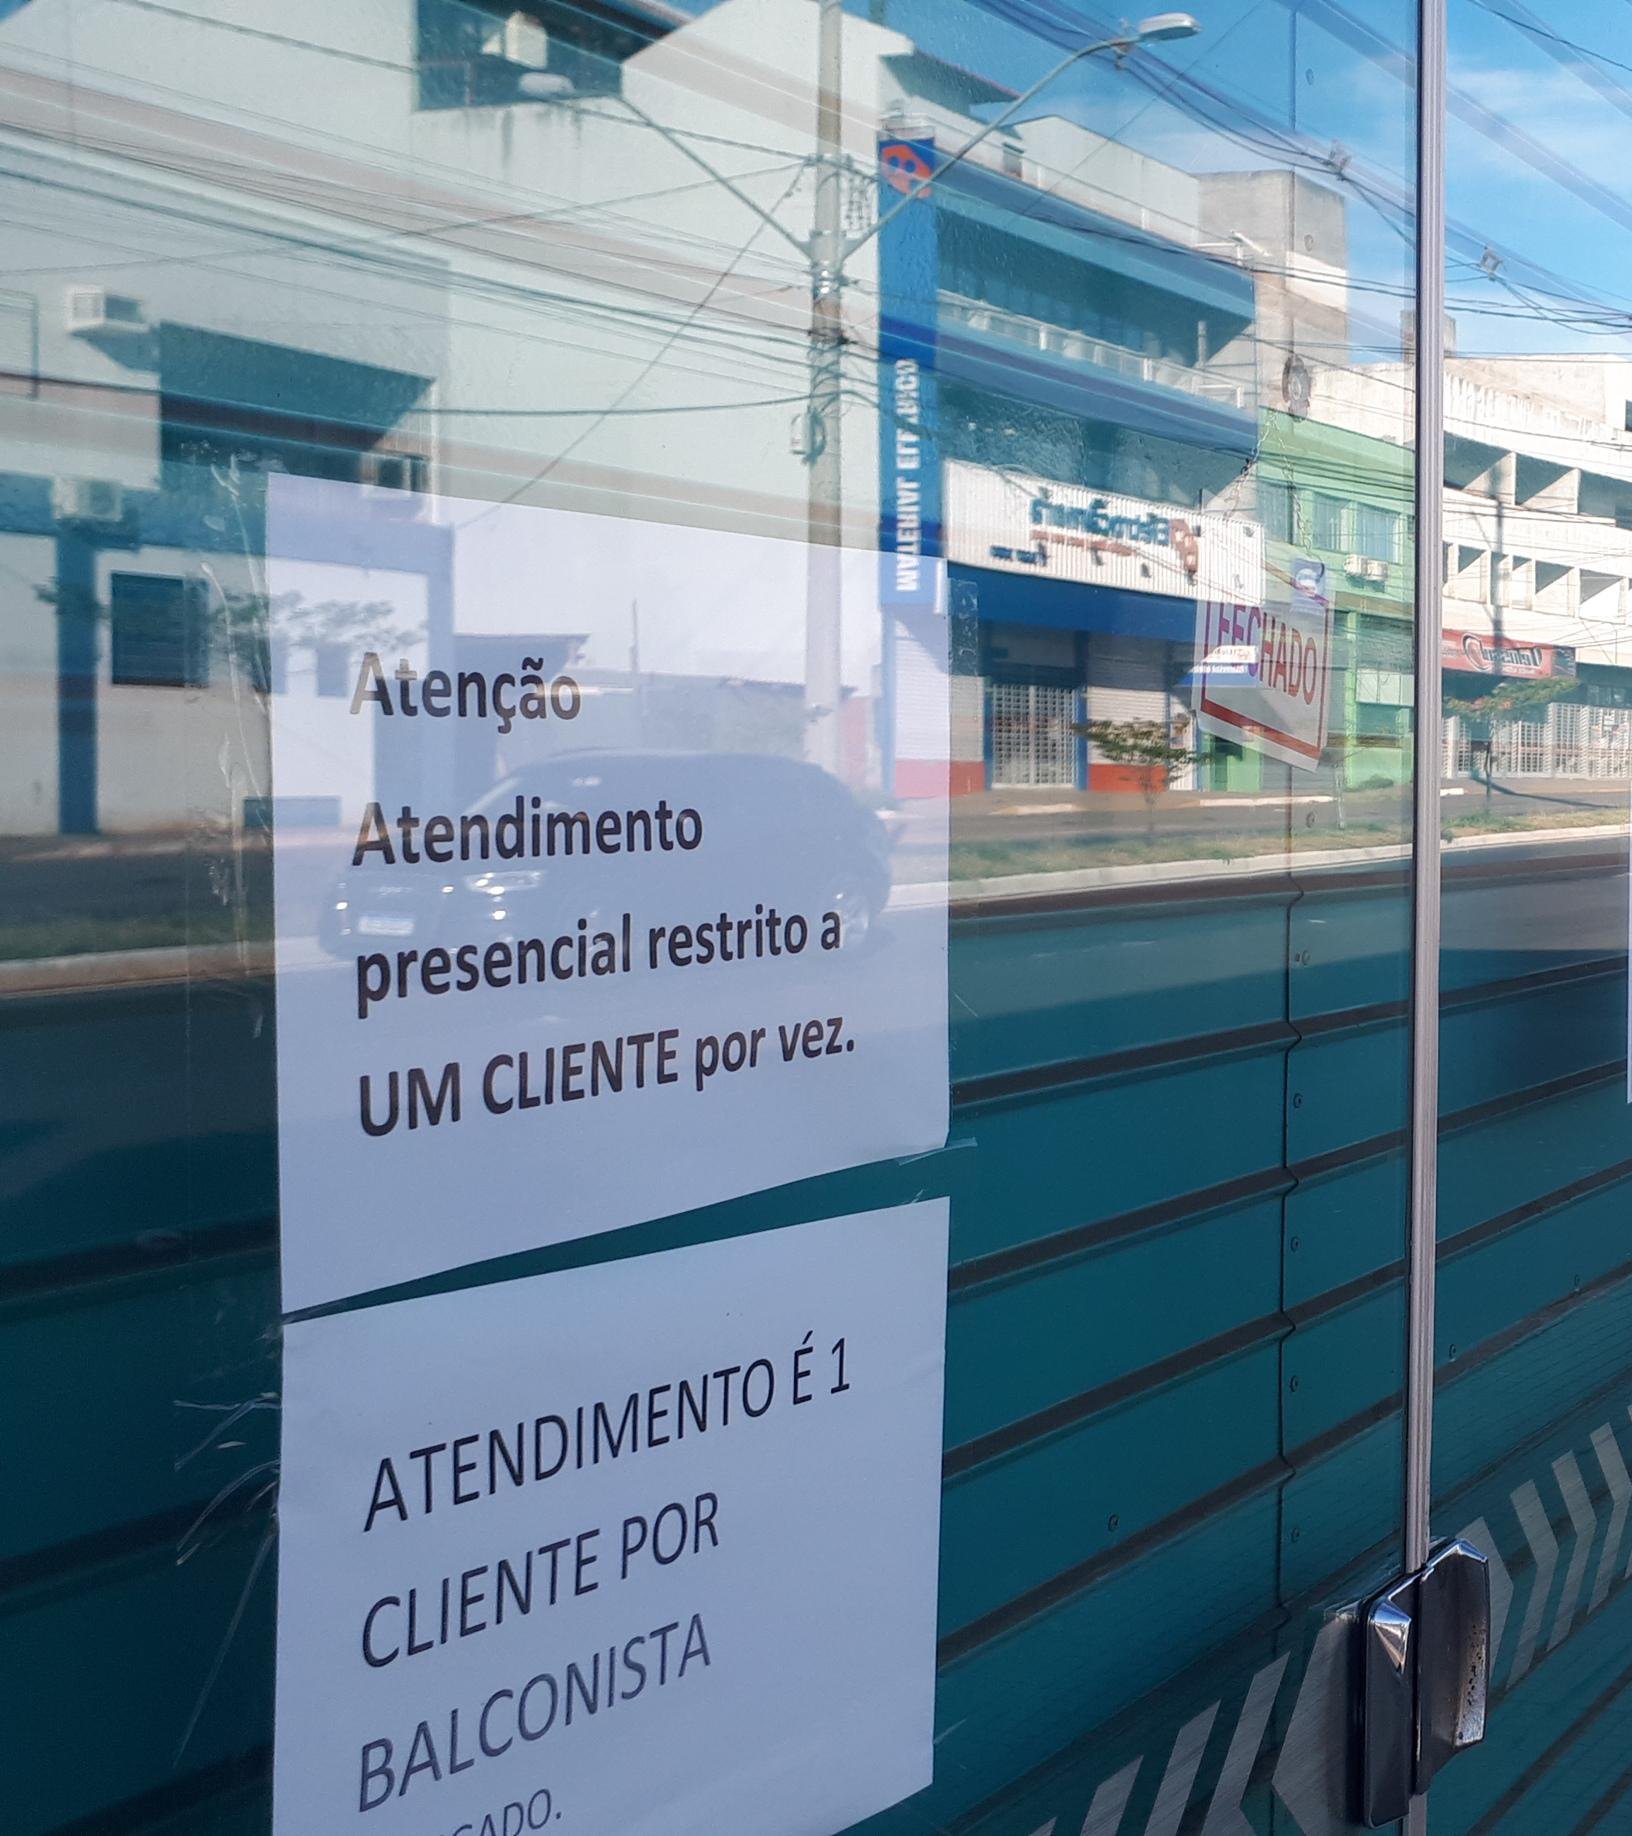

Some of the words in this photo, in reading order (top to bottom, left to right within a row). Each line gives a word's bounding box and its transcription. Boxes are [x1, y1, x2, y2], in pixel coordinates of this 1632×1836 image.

[350, 652, 582, 733] Atenção
[1216, 601, 1318, 705] FECHADO
[352, 796, 702, 866] Atendimento
[357, 913, 631, 1019] presencial
[648, 904, 808, 969] restrito
[820, 911, 842, 949] a
[360, 1063, 461, 1136] UM
[483, 1029, 679, 1114] CLIENTE
[695, 1027, 766, 1091] por
[778, 1015, 855, 1061] vez.
[363, 1358, 775, 1532] ATENDIMENTO
[791, 1330, 814, 1406] É
[828, 1337, 851, 1395] 1
[361, 1528, 600, 1668] CLIENTE
[620, 1491, 720, 1580] POR
[358, 1613, 711, 1812] BALCONISTA
